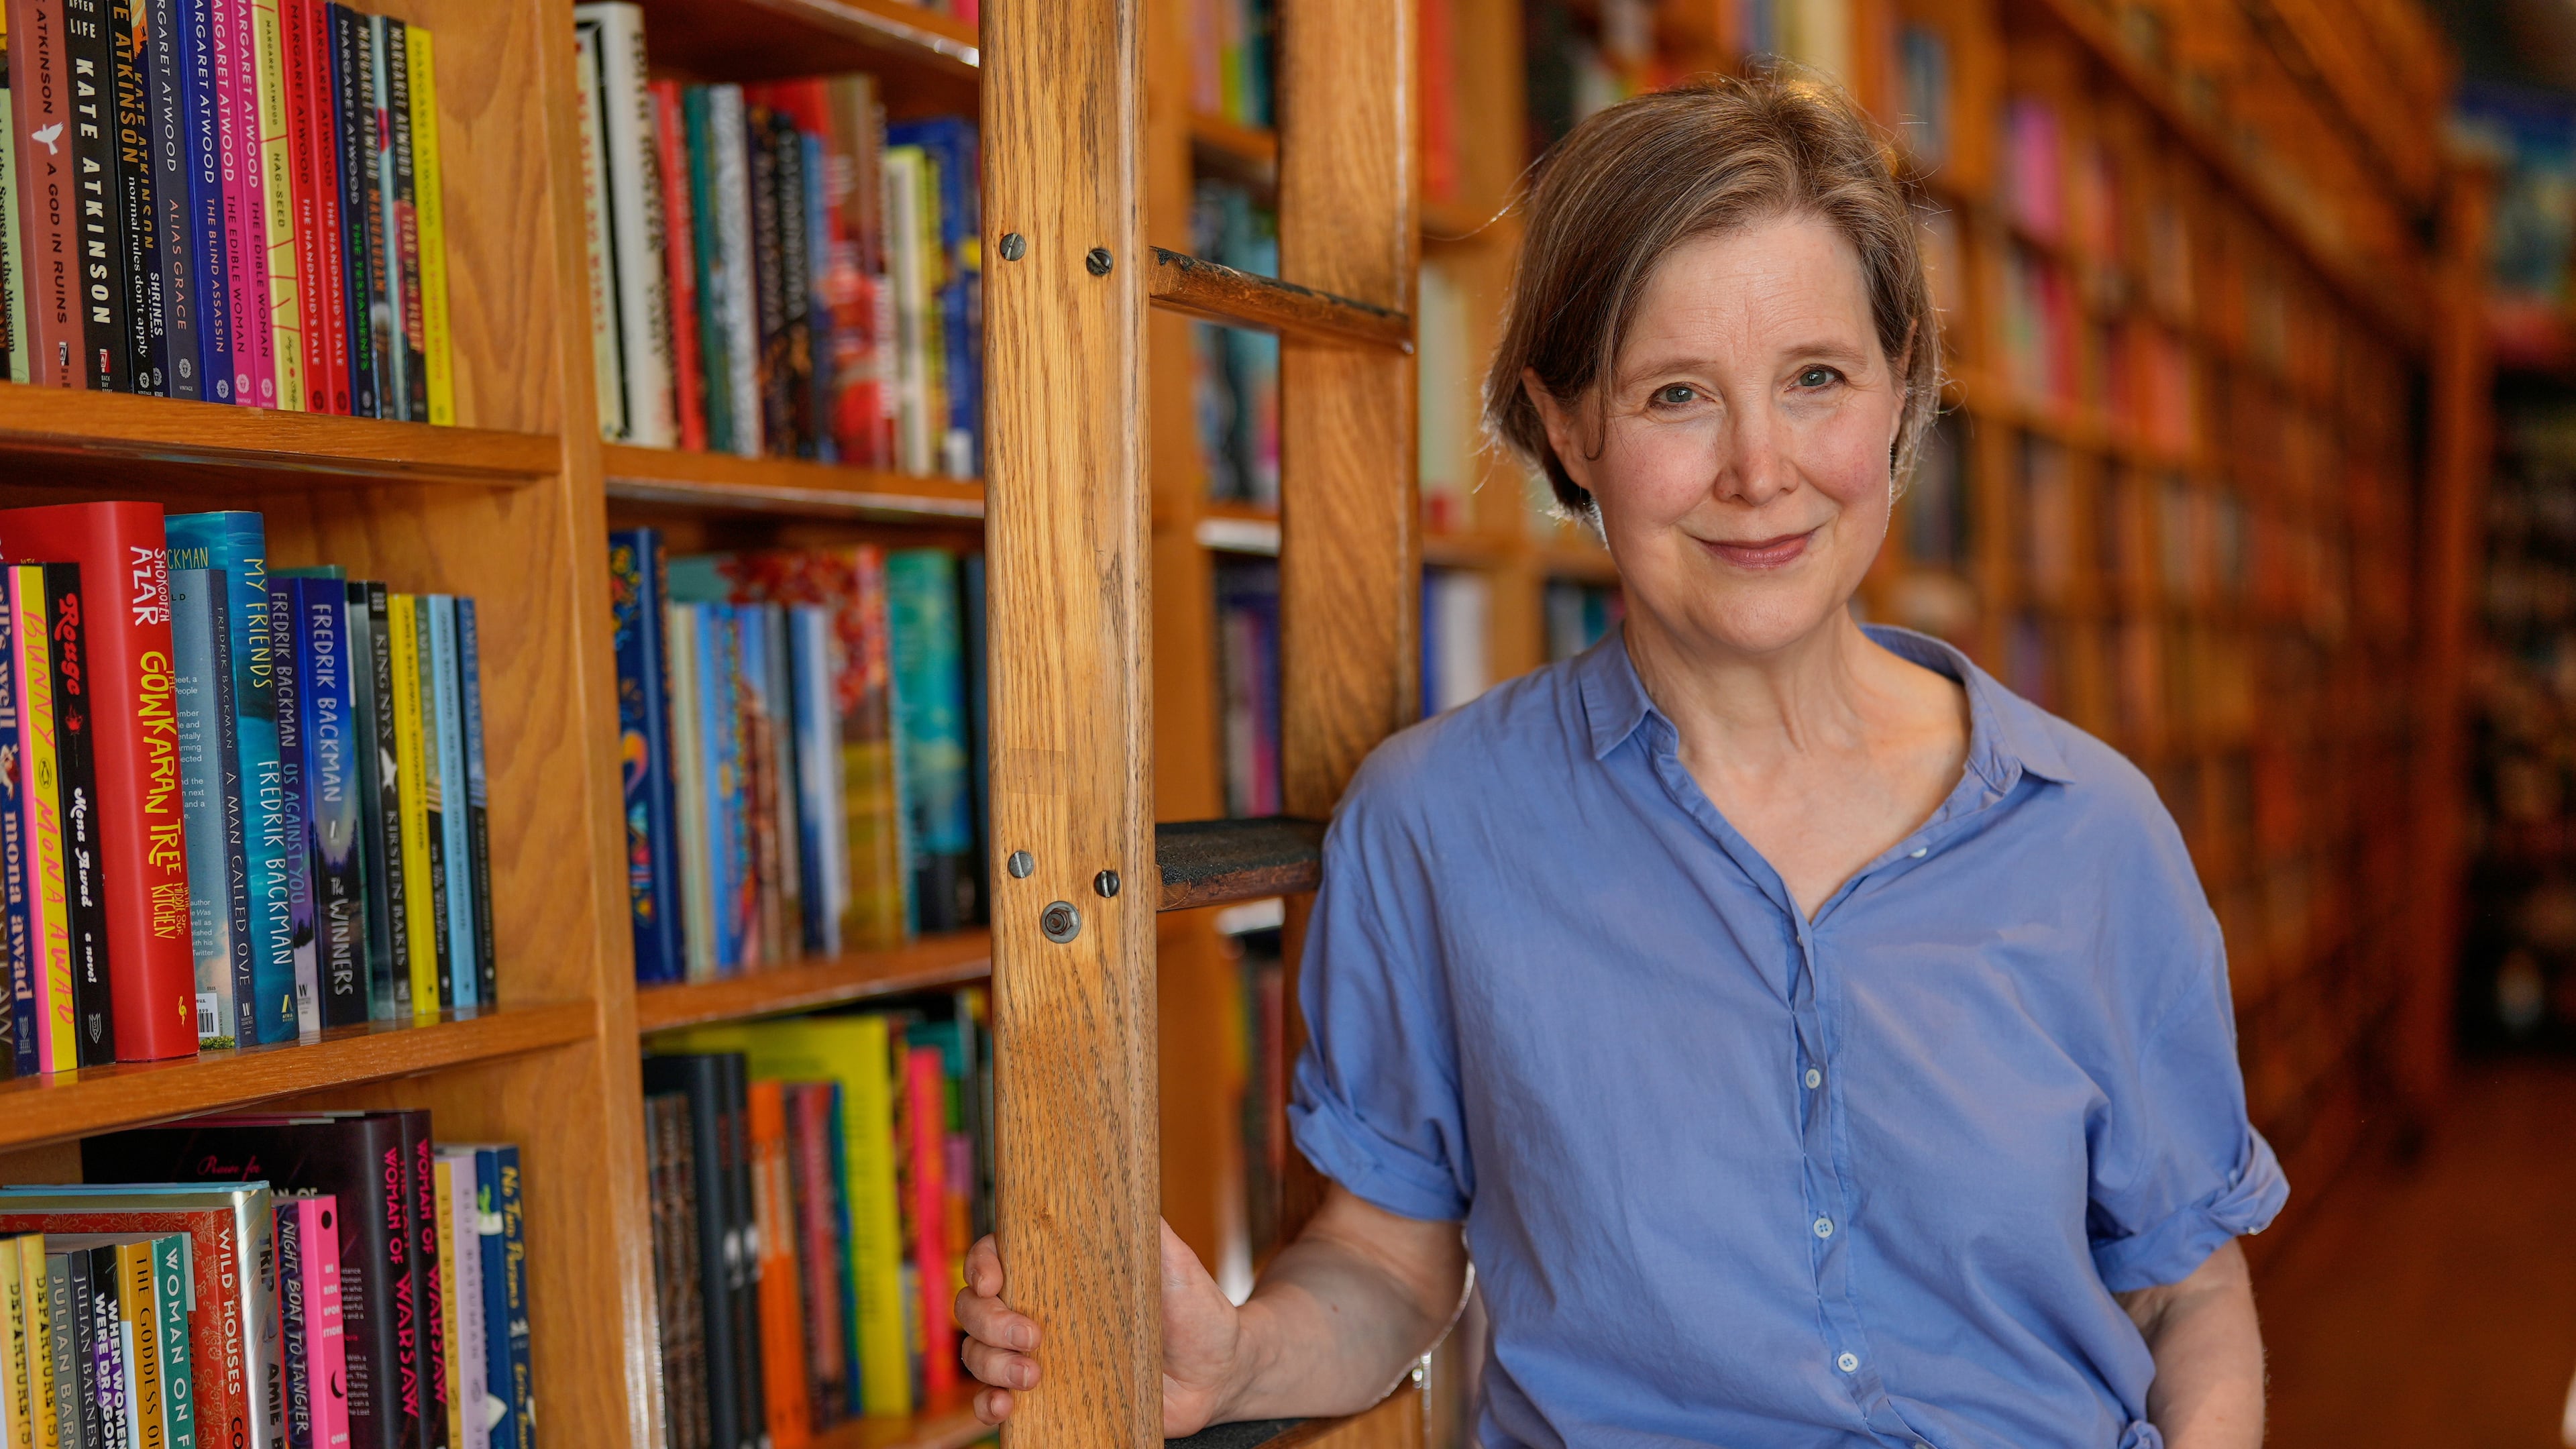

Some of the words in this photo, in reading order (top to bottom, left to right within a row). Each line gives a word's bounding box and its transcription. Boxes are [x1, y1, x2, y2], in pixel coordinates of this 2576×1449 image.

[70, 18, 96, 38] LIFE
[156, 0, 170, 76] RGARET
[194, 0, 209, 90] ARGARET
[213, 0, 229, 89] ARGARET
[290, 5, 305, 99] MARGARET
[315, 9, 329, 104] MARGARET
[36, 8, 53, 114] ATKINSON
[340, 19, 356, 121] MARGARET
[358, 25, 375, 110] MARGARET
[390, 26, 409, 110] MARGARET
[76, 58, 98, 139] KATE
[115, 32, 139, 163] ATKINSON
[134, 72, 146, 127] KATE
[161, 82, 176, 172] ATWOOD
[46, 162, 56, 176] A
[199, 94, 215, 184] ATWOOD
[219, 93, 235, 182] ATWOOD
[244, 101, 258, 189] ATWOOD
[296, 106, 309, 184] ATWOOD
[321, 109, 333, 187] ATWOOD
[346, 123, 360, 205] ATWOOD
[48, 183, 59, 225] GOD
[128, 176, 141, 231] normal
[207, 199, 215, 226] THE
[227, 196, 237, 223] THE
[252, 203, 260, 229] THE
[273, 153, 286, 228] HAG-SEED
[303, 198, 313, 225] THE
[52, 233, 62, 253] IN
[83, 157, 111, 324] ATKINSON
[132, 235, 142, 272] rules
[169, 199, 182, 255] ALIAS
[208, 231, 220, 276] BLIND
[229, 229, 241, 282] EDIBLE
[352, 223, 363, 256] THE
[3, 261, 11, 287] the
[54, 260, 67, 324] RUINS
[254, 235, 264, 288] EDIBLE
[305, 229, 319, 327] HANDMAID'S
[5, 290, 15, 353] Museum
[135, 275, 144, 314] don't
[150, 272, 163, 336] SHRINES
[174, 261, 187, 330] GRACE
[211, 280, 225, 352] ASSASSIN
[233, 288, 246, 352] WOMAN
[258, 294, 269, 358] WOMAN
[355, 261, 370, 372] TESTAMENTS
[136, 317, 148, 358] apply
[311, 331, 321, 366] TALE
[334, 333, 345, 367] TALE
[130, 546, 159, 627] AZAR
[154, 547, 170, 623] SHOKOOFEH
[244, 558, 266, 593] MY
[54, 592, 80, 696] Rouge
[217, 606, 228, 669] FREDRIK
[246, 602, 273, 689] FRIENDS
[271, 592, 291, 660] FREDRIK
[311, 604, 336, 690] FREDRIK
[23, 610, 56, 749] BUNNY
[276, 665, 297, 748] BACKMAN
[186, 720, 200, 729] and
[221, 676, 233, 749] BACKMAN
[225, 772, 237, 785] A
[283, 763, 299, 785] US
[316, 697, 343, 802] BACKMAN
[70, 787, 87, 843] Mona
[184, 800, 197, 808] and
[227, 796, 241, 844] MAN
[257, 760, 286, 847] FREDRIK
[284, 790, 303, 860] AGAINST
[4, 811, 22, 905] mona
[74, 847, 93, 908] Awad
[148, 818, 182, 876] TREE
[386, 810, 403, 900] KIRSTEN
[150, 882, 176, 939] KITCHEN
[190, 898, 211, 906] author
[231, 855, 247, 932] CALLED
[264, 857, 294, 966] BACKMAN
[288, 867, 306, 904] YOU
[11, 914, 33, 1001] awad
[85, 946, 97, 983] novel
[237, 942, 251, 986] OVE
[329, 898, 354, 996] WINNERS
[392, 905, 407, 967] BAKIS
[384, 1146, 401, 1229] WOMAN
[417, 1138, 433, 1220] WOMAN
[219, 1228, 233, 1289] WILD
[259, 1232, 275, 1293] TRIP
[282, 1220, 298, 1274] NIGHT
[390, 1237, 404, 1265] OF
[422, 1227, 435, 1254] OF
[136, 1254, 150, 1298] THE
[166, 1247, 184, 1364] WOMAN
[287, 1279, 303, 1326] BOAT
[53, 1275, 71, 1373] JULIAN
[74, 1275, 92, 1353] JULIAN
[95, 1292, 109, 1355] WERE
[107, 1298, 121, 1364] WHEN
[288, 1331, 303, 1356] TO
[396, 1270, 420, 1418] WARSAW
[140, 1307, 158, 1415] GODDESS
[223, 1300, 241, 1395] HOUSES
[82, 1361, 98, 1448] BARNES
[173, 1377, 189, 1422] ON
[268, 1362, 282, 1426] AMIE
[293, 1360, 309, 1435] TANGIER
